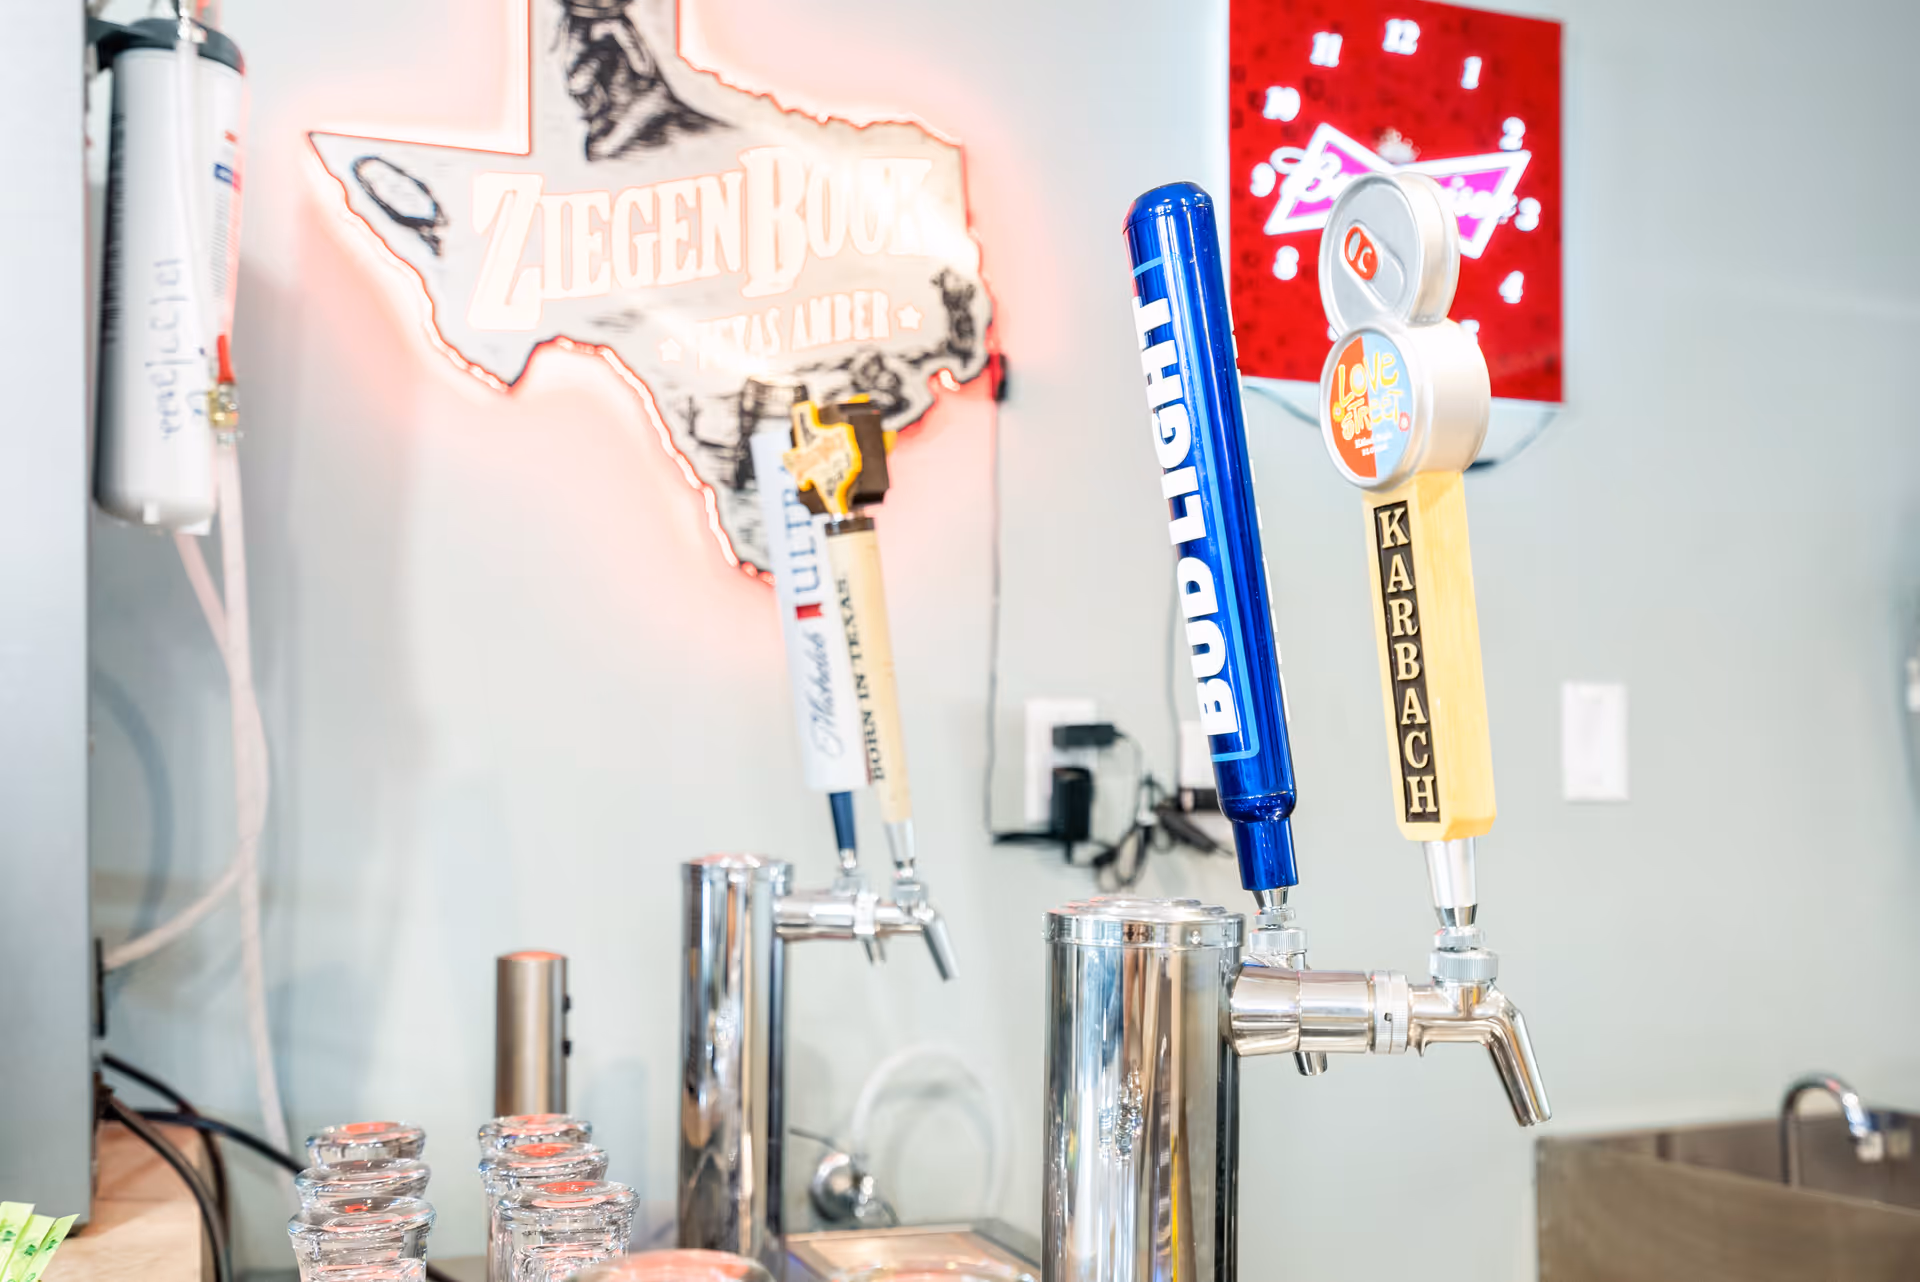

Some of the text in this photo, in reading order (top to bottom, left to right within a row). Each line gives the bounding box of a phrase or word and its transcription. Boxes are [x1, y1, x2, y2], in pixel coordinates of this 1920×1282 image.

[1310, 31, 1343, 67] 11
[1383, 18, 1420, 55] 12
[1461, 56, 1482, 89] 1
[1263, 86, 1301, 121] 10
[1499, 271, 1524, 303] 4
[1132, 295, 1239, 736] BUD LIGHT
[836, 575, 885, 781] BORN IN TEXAS
[1378, 506, 1439, 814] KARBACH
